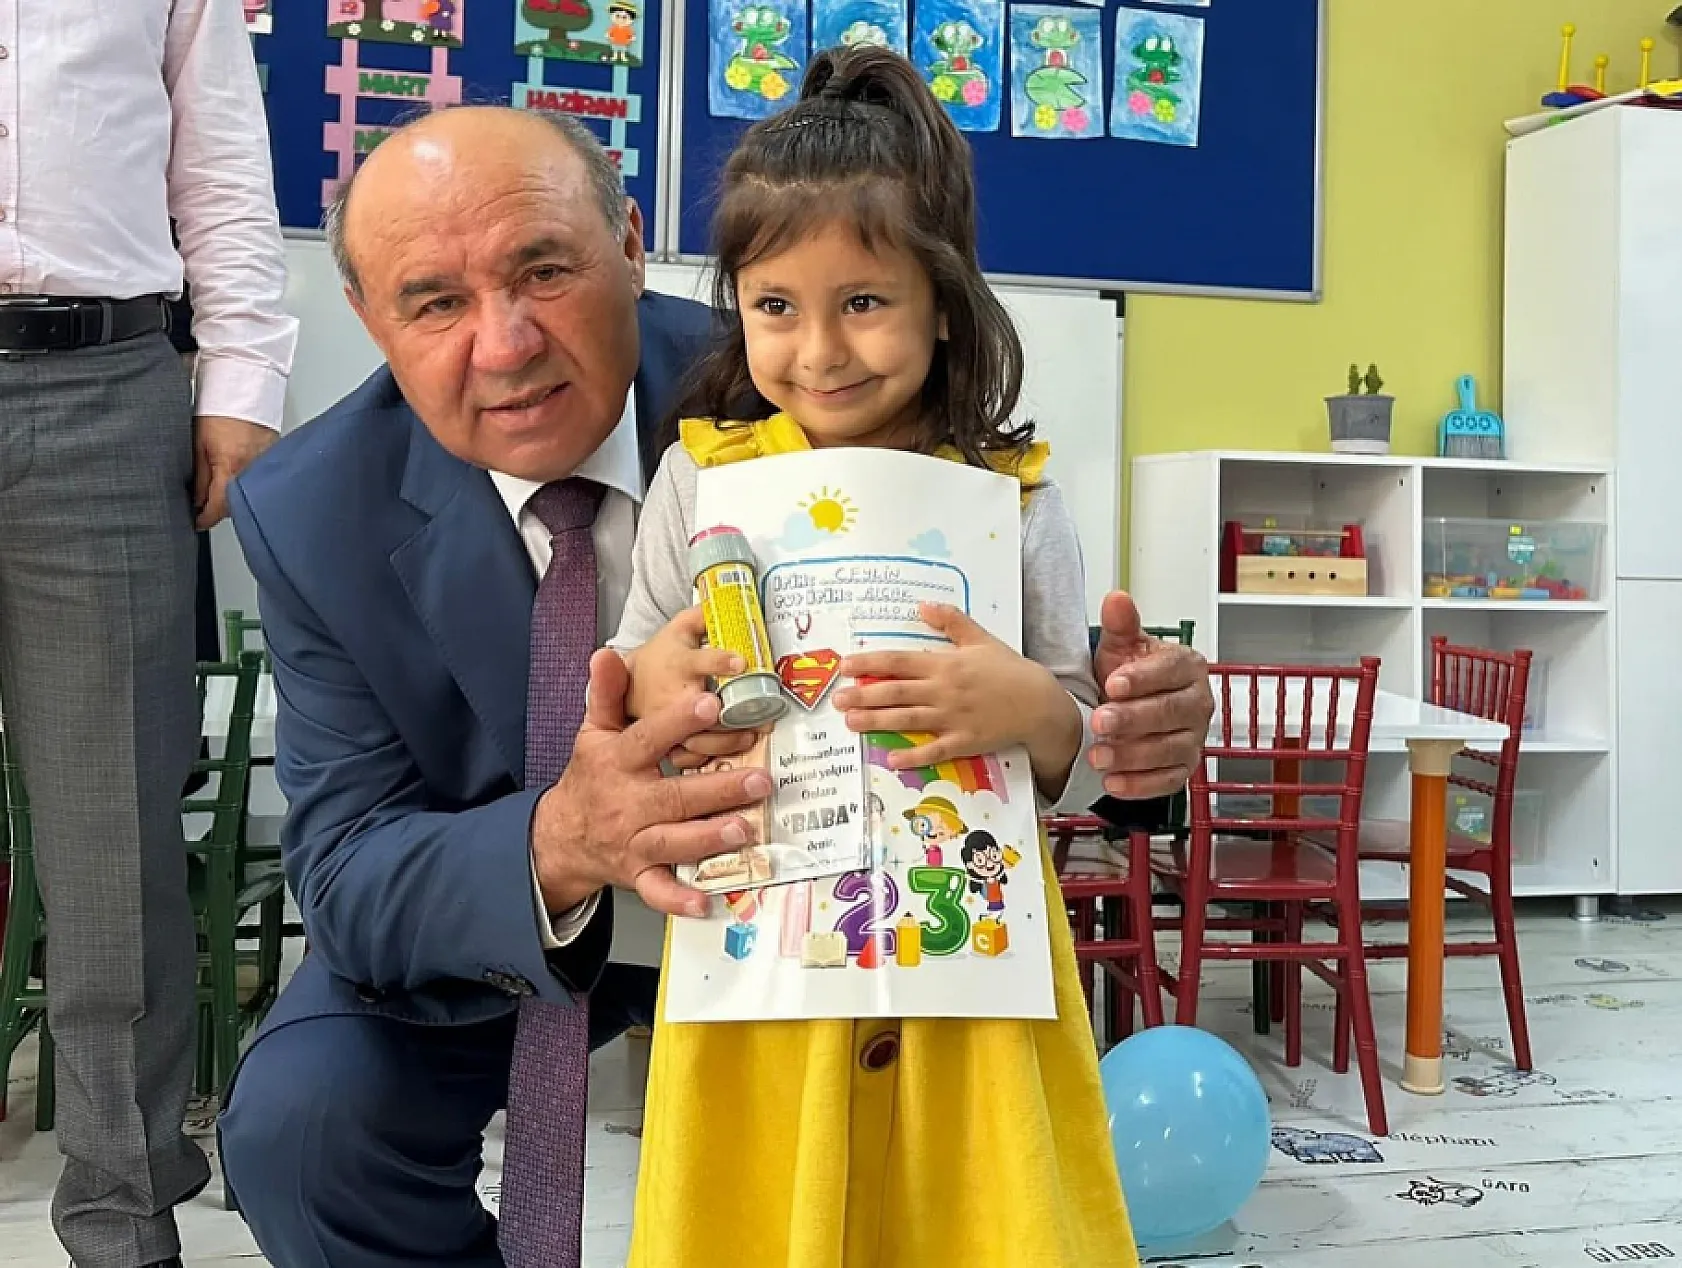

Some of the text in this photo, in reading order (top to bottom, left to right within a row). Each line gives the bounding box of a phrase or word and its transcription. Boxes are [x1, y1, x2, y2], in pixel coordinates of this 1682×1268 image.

[358, 72, 431, 97] MART
[526, 89, 628, 118] HAZİRAN
[907, 866, 971, 957] 3
[1481, 1178, 1530, 1193] GATO
[1583, 1241, 1675, 1263] GLOBO
